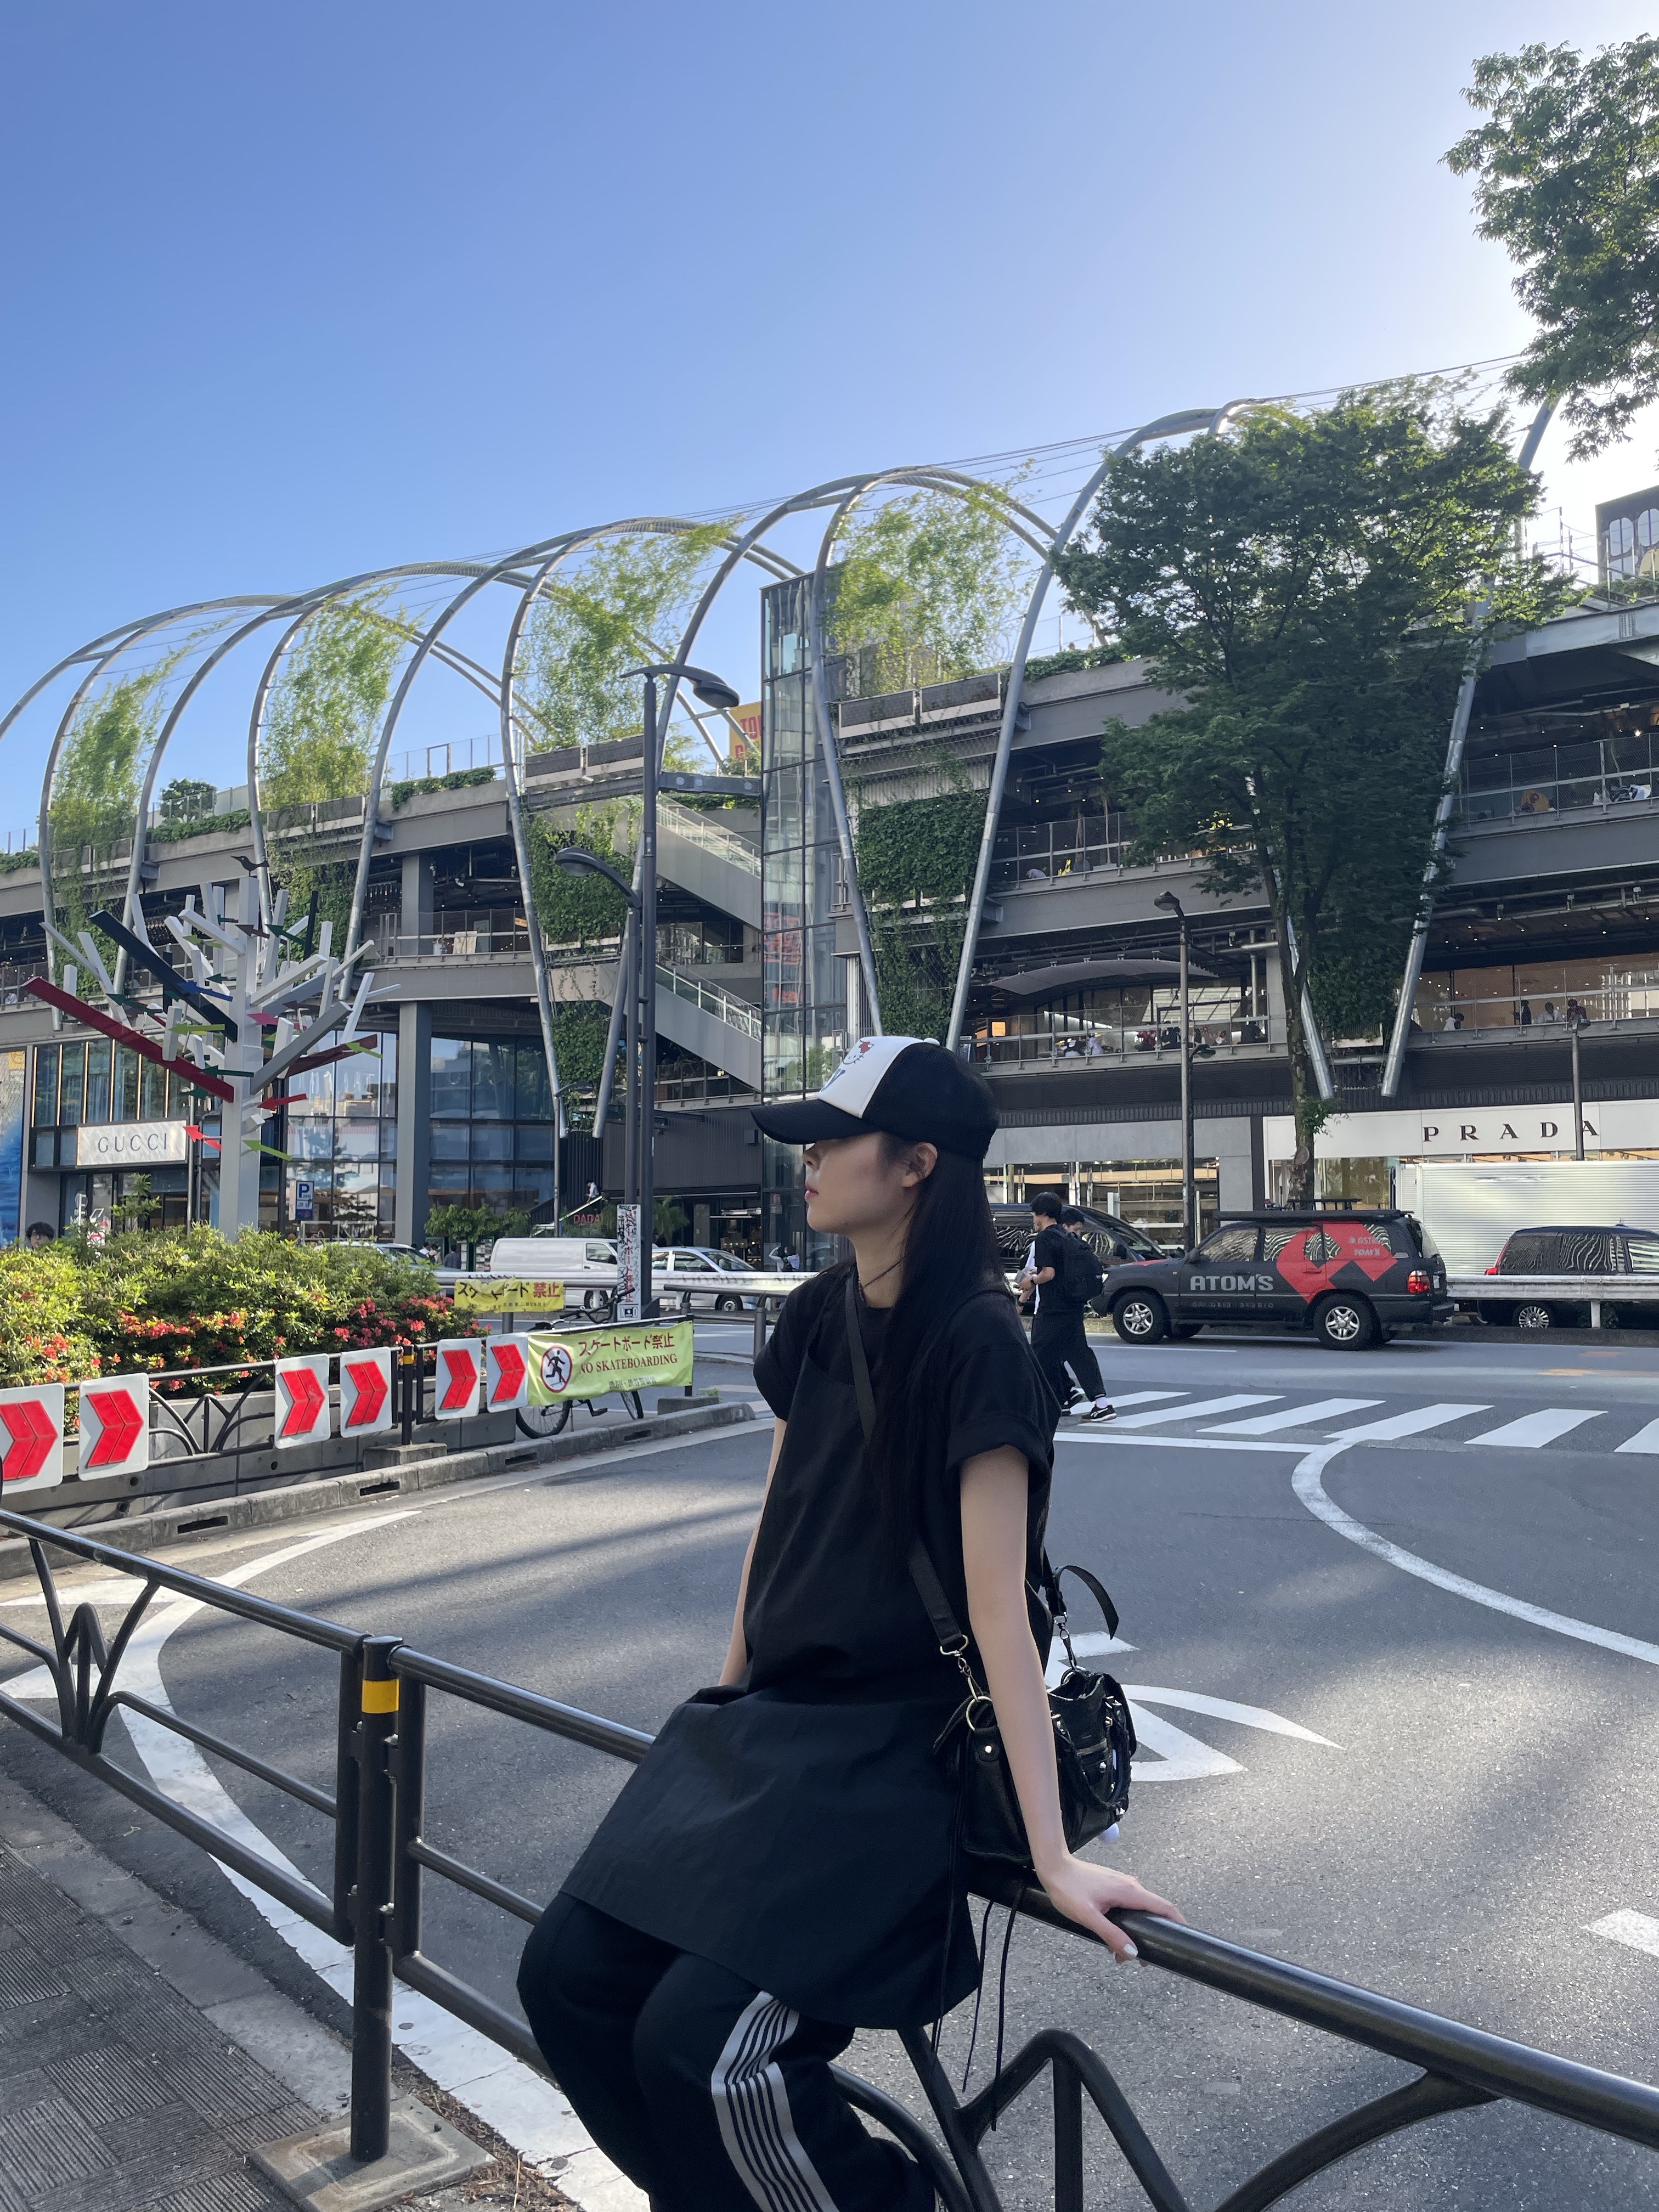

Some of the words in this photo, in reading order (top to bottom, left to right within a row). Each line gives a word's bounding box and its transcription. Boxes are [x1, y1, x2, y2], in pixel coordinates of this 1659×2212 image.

[1423, 1120, 1599, 1142] PRADA
[98, 1133, 167, 1153] GUCCI
[299, 1183, 310, 1198] P
[1190, 1274, 1274, 1291] ATOM'S
[578, 1332, 675, 1357] スケートボード禁止
[579, 1362, 594, 1375] NO
[596, 1353, 678, 1372] SKATEBOARDING
